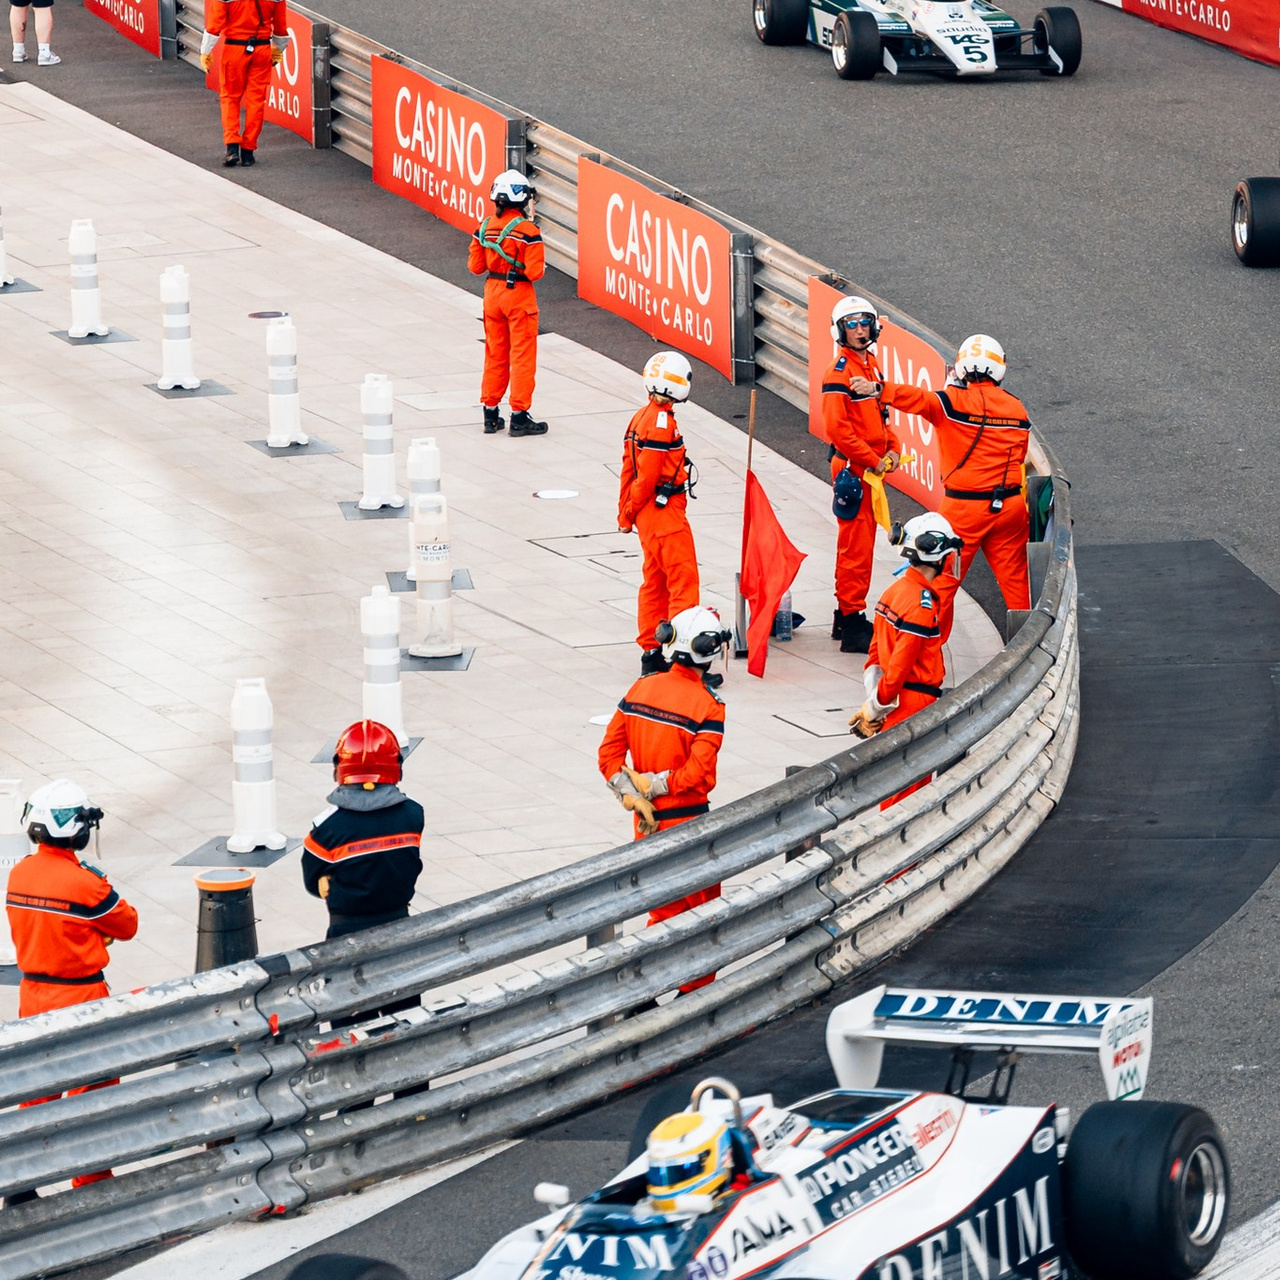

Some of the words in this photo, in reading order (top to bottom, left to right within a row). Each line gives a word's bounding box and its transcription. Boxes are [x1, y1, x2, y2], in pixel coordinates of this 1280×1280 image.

[963, 46, 988, 63] 5
[268, 85, 300, 119] ARLO
[396, 86, 487, 187] CASINO
[606, 192, 712, 306] CASINO
[900, 442, 935, 492] ARLO
[893, 993, 1129, 1025] DENIM
[813, 1124, 915, 1197] PIONEER
[830, 1191, 864, 1219] CAR
[549, 1233, 676, 1271] NIM
